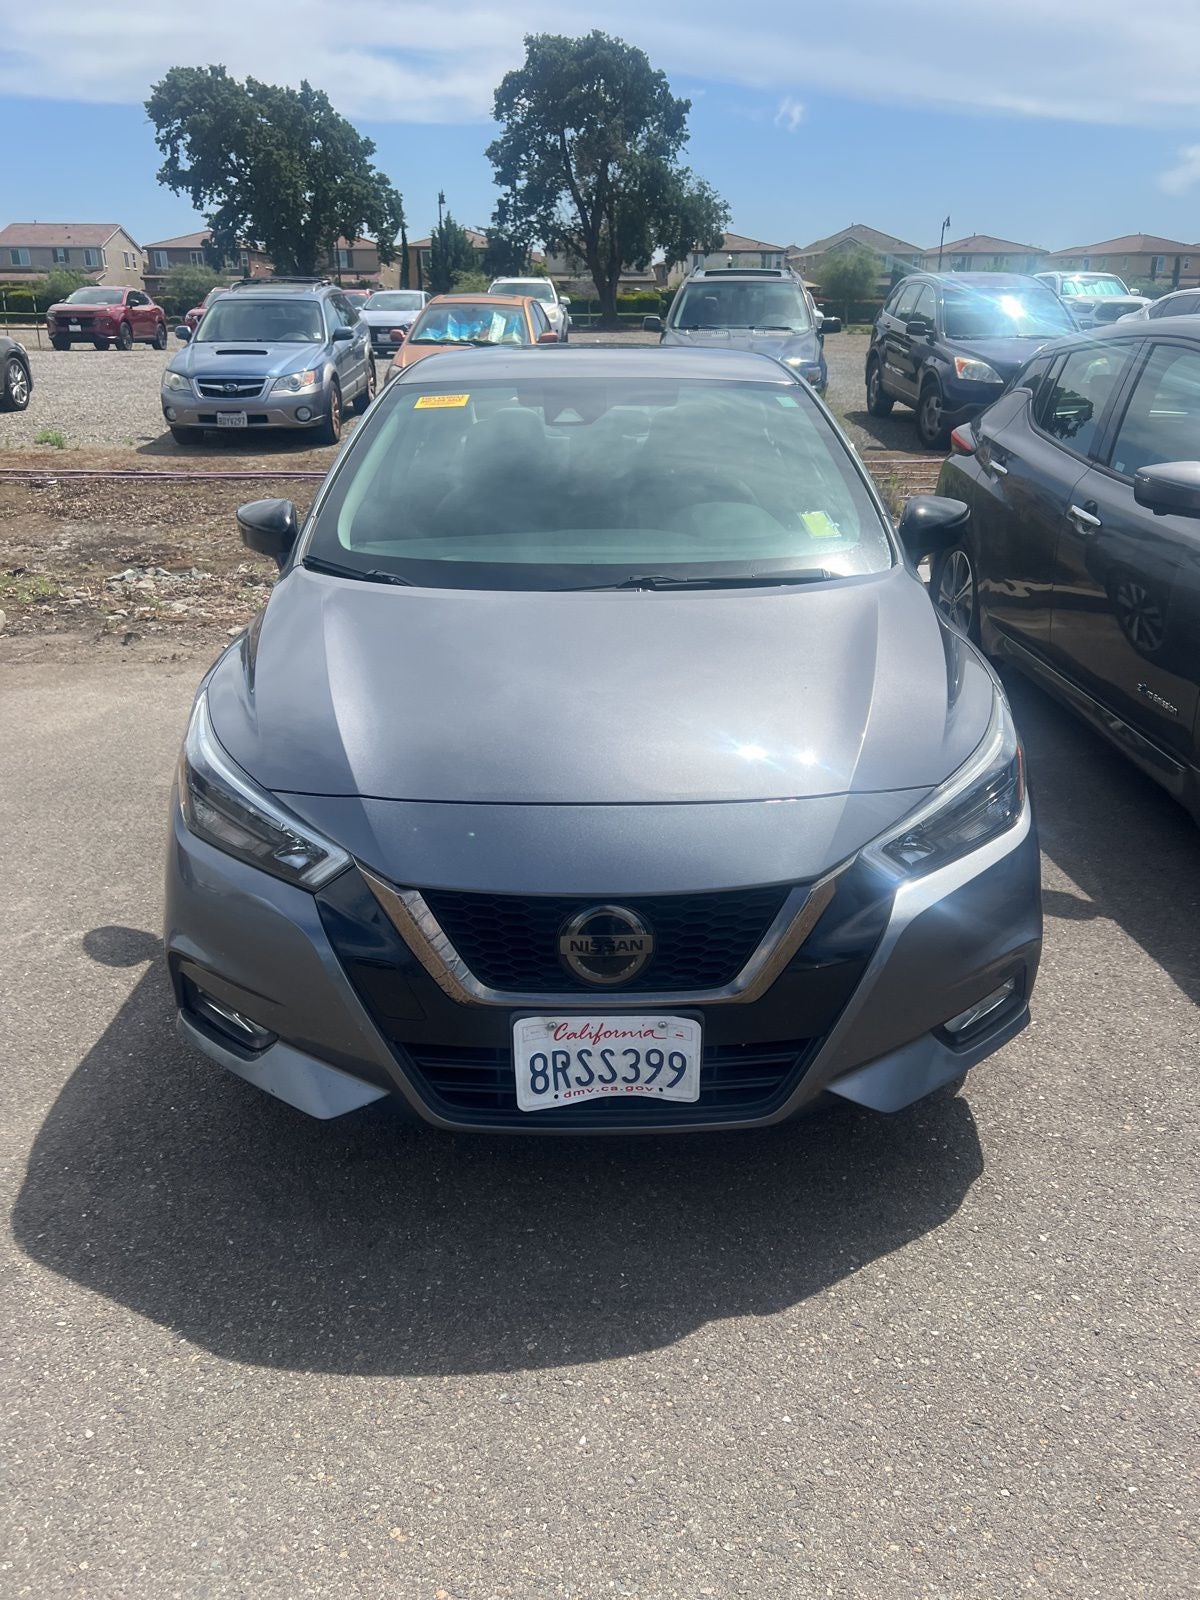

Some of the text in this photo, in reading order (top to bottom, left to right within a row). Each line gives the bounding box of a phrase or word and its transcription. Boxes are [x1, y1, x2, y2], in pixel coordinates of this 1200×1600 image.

[569, 940, 644, 953] NISSAN
[553, 1022, 667, 1046] California
[529, 1048, 687, 1095] 8RSS399
[563, 1085, 654, 1099] dmv.ca.gov
